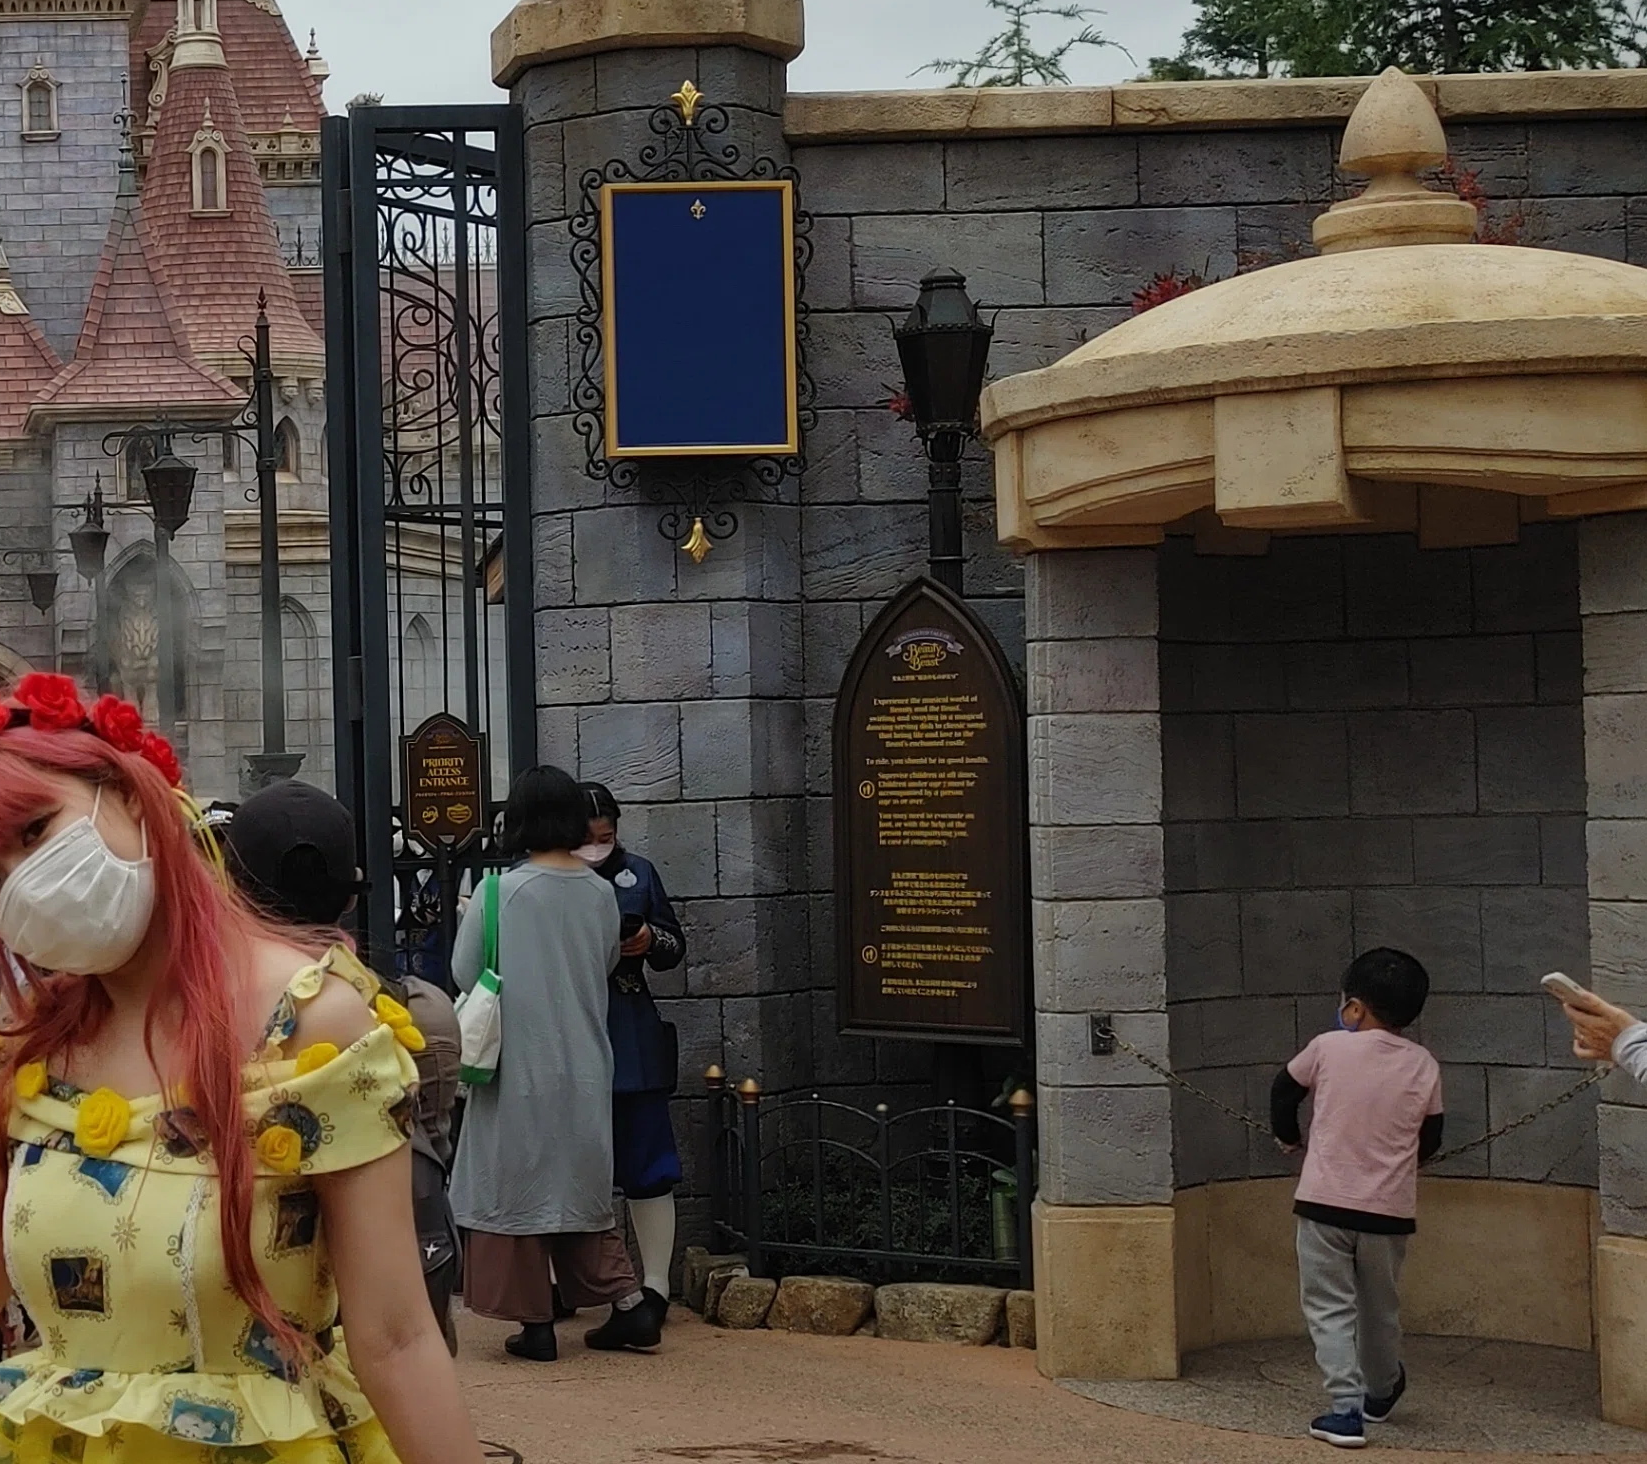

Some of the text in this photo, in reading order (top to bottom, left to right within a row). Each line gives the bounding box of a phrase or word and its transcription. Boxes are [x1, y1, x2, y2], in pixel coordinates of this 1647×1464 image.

[903, 643, 946, 661] Beauty
[909, 658, 939, 670] Beast
[423, 757, 465, 768] PRIORITY
[427, 767, 461, 777] ACCESS
[419, 777, 469, 787] ENTRANCE
